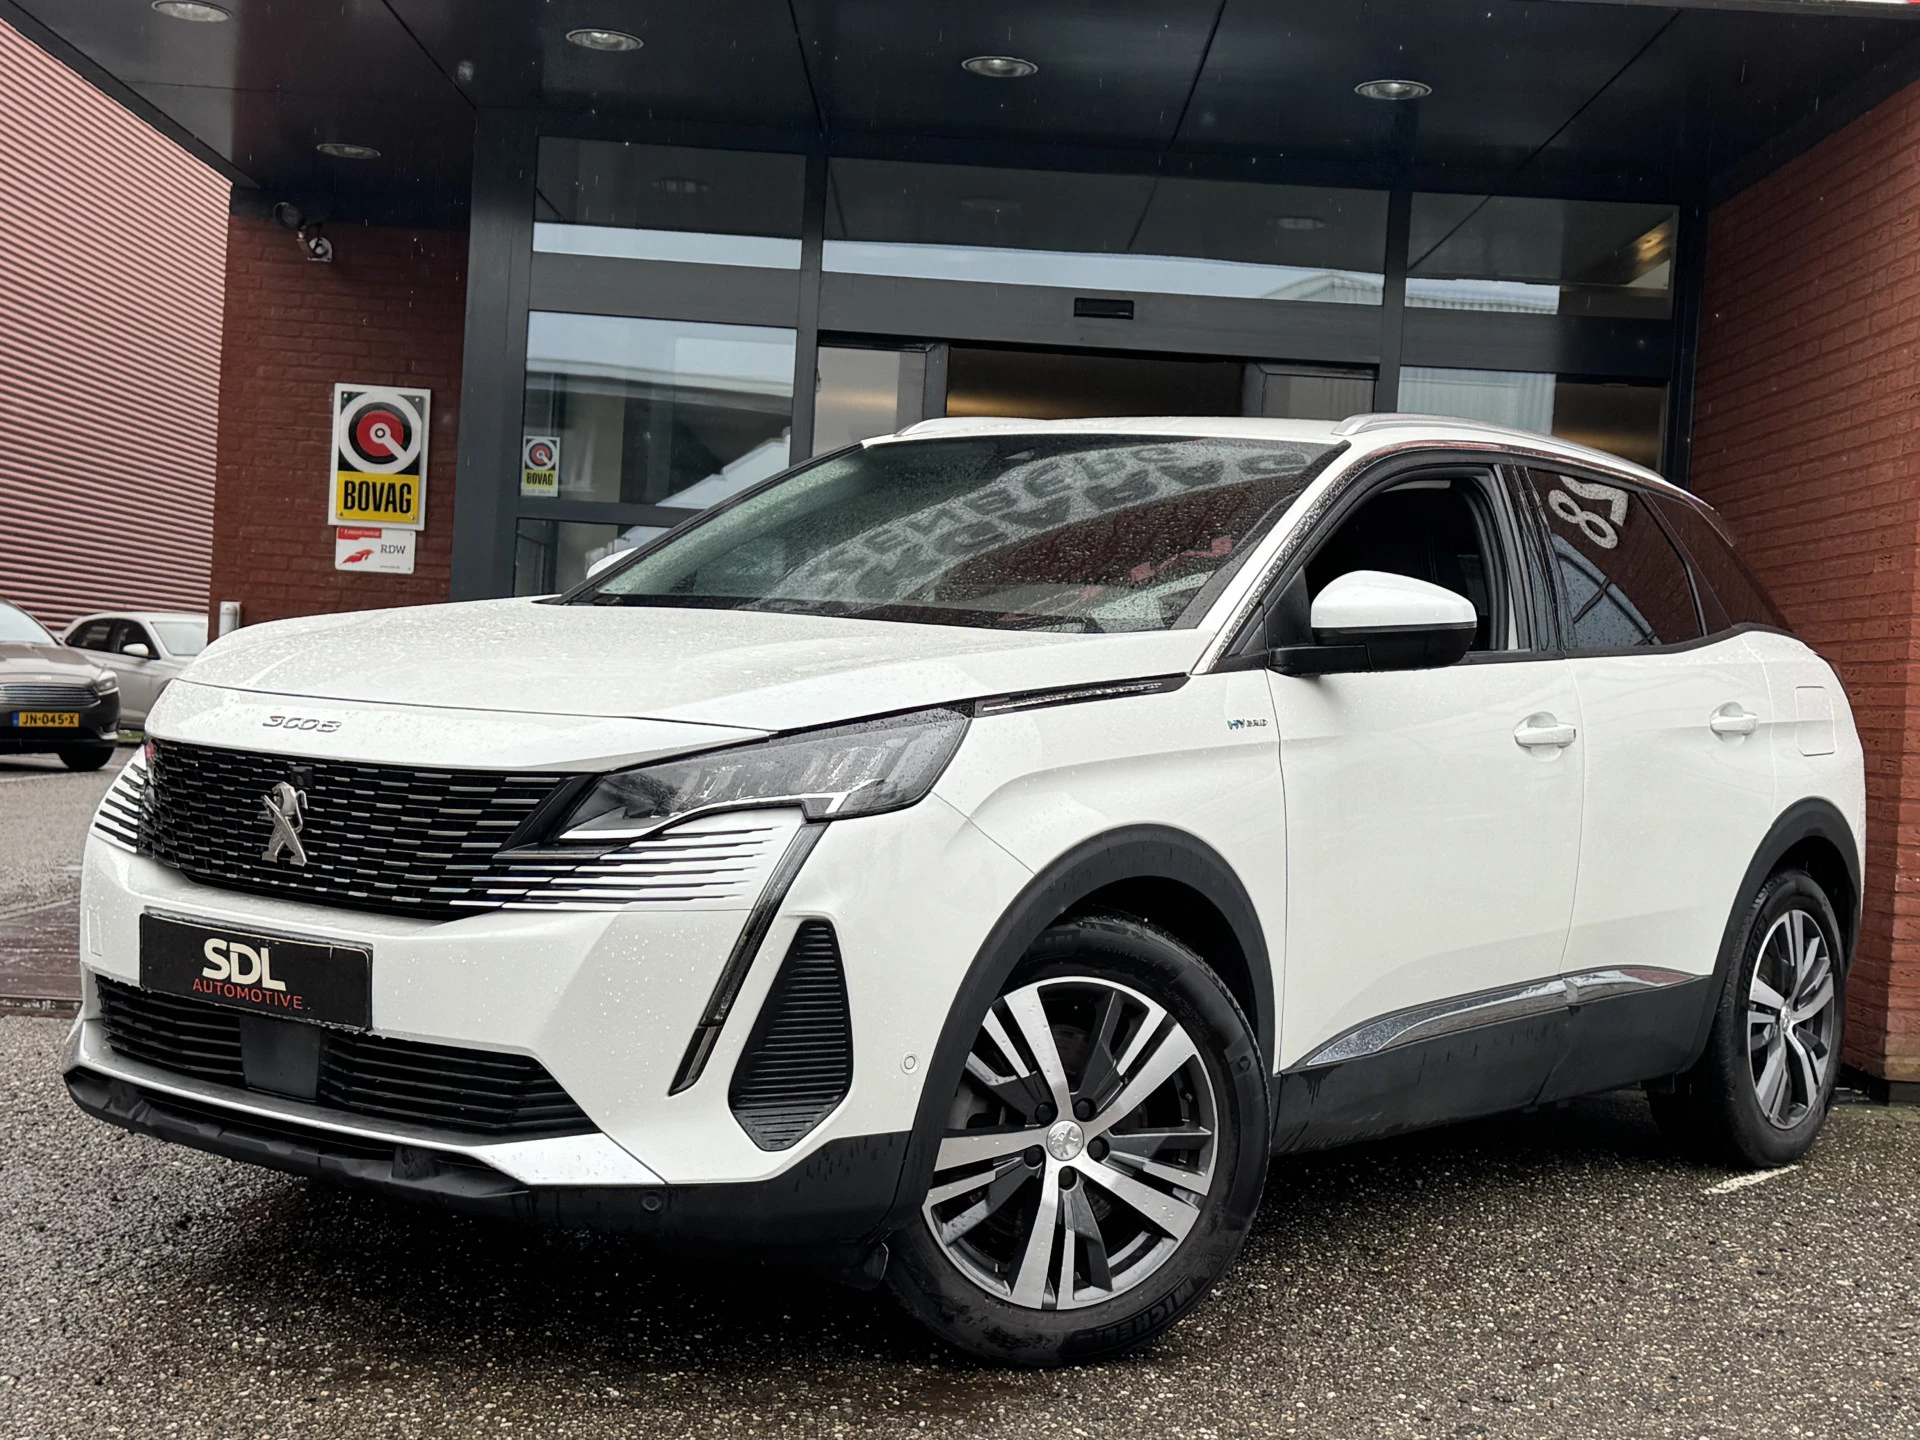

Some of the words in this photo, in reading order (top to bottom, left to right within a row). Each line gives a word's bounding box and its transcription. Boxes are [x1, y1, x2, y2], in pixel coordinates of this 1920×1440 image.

[526, 473, 554, 485] BOVAG
[343, 480, 412, 514] BOVAG
[380, 544, 406, 554] RDW
[262, 715, 342, 733] 3008
[202, 938, 286, 991] SDL
[192, 978, 303, 1010] AUTOMOTIVE
